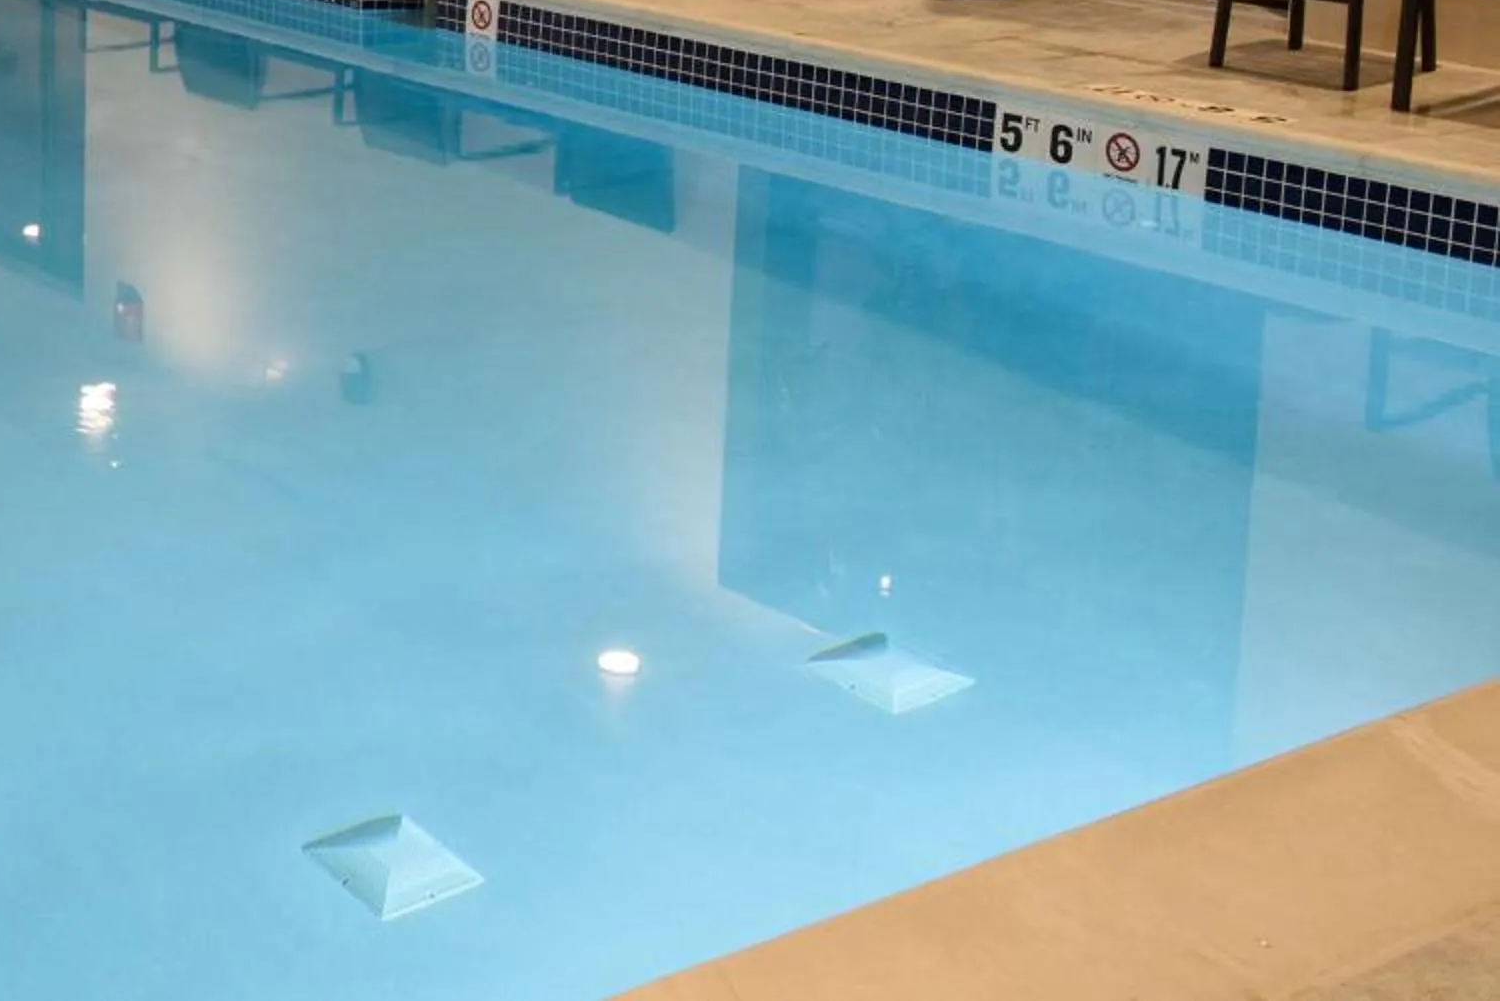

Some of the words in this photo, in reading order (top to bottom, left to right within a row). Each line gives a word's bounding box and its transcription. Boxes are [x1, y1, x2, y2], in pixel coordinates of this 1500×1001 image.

[1000, 112, 1024, 153] 5
[1025, 117, 1041, 134] FT
[1050, 124, 1073, 164] 6
[1076, 127, 1093, 145] IN
[1189, 152, 1200, 165] M
